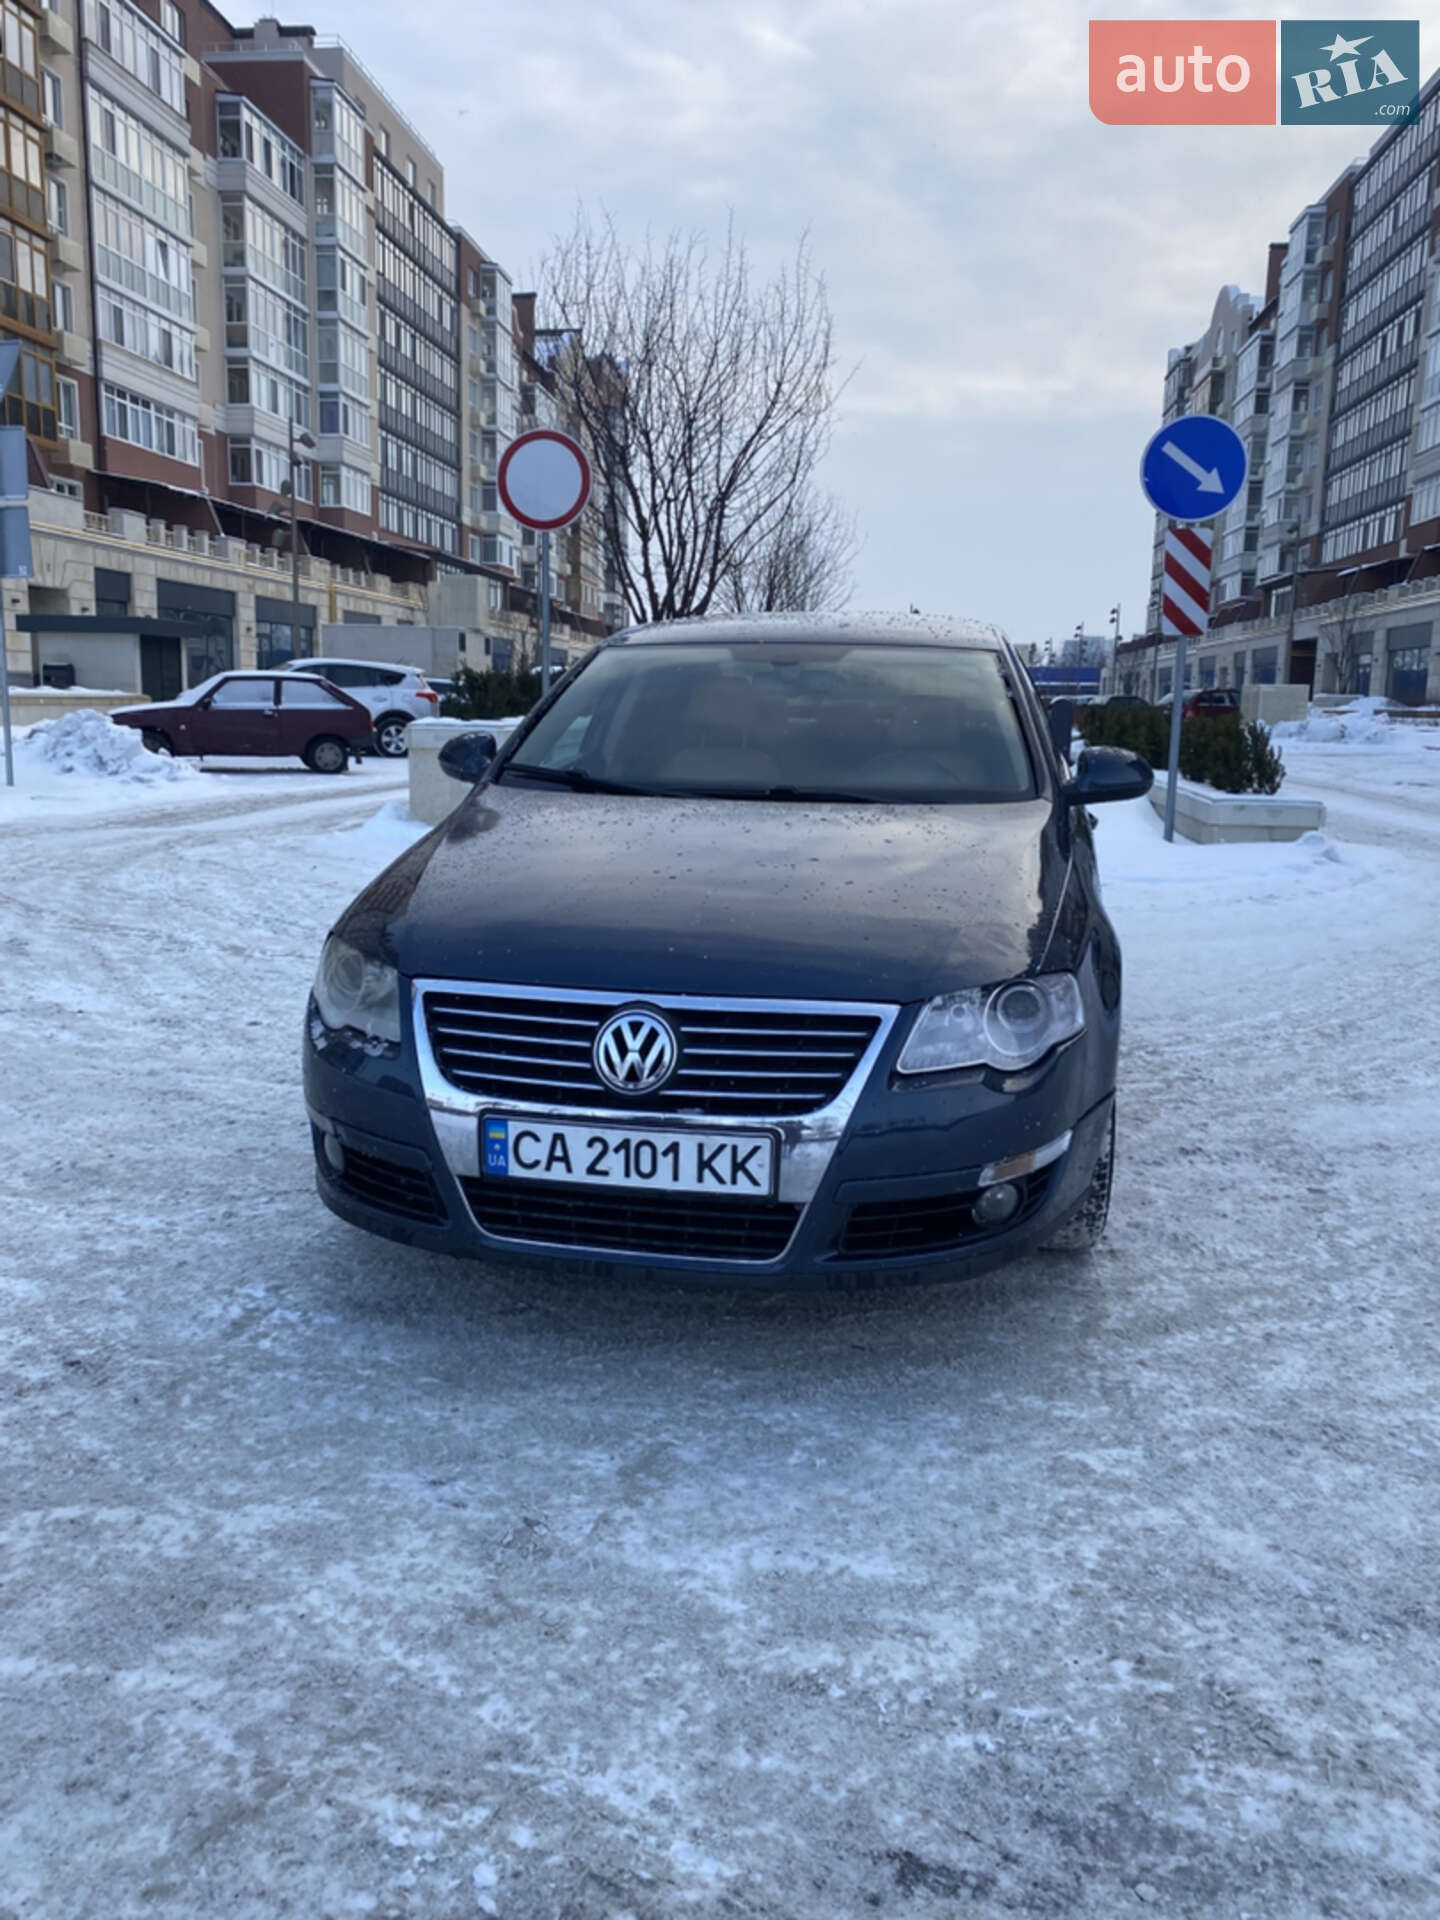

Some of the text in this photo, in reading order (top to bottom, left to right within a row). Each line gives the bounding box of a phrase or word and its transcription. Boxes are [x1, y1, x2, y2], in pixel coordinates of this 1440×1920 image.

[488, 1155, 507, 1168] UA
[512, 1130, 763, 1187] CA 2101 KK
